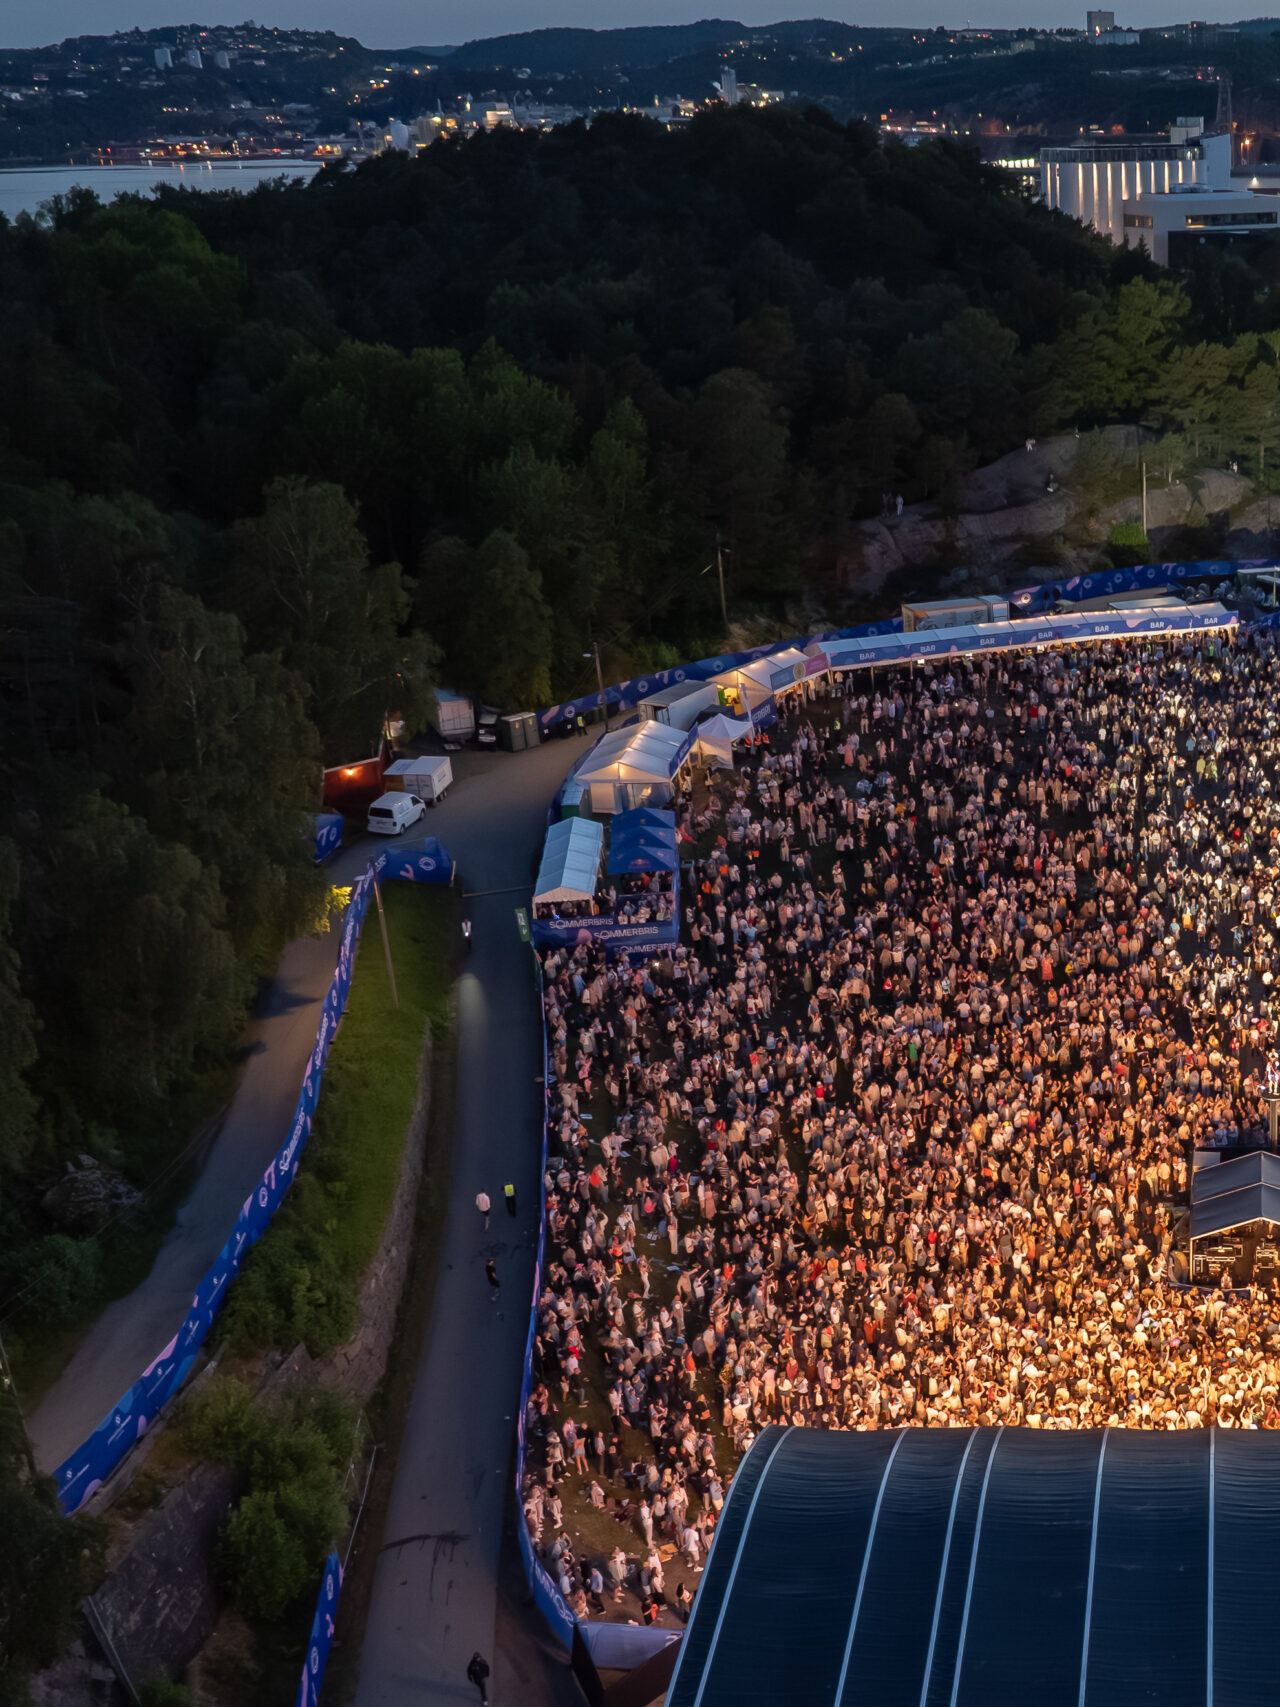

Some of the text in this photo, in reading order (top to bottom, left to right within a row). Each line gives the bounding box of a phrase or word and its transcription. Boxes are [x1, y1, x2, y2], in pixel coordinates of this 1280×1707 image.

[1150, 621, 1165, 629] BAR
[1204, 617, 1218, 625] BAR
[1095, 625, 1109, 633] BAR
[1038, 631, 1053, 640] BAR
[979, 637, 995, 646] BAR
[920, 644, 936, 654] BAR
[859, 652, 876, 660] BAR
[549, 918, 614, 930] SOMMERBRIS
[594, 926, 659, 939] SOMMERBRIS
